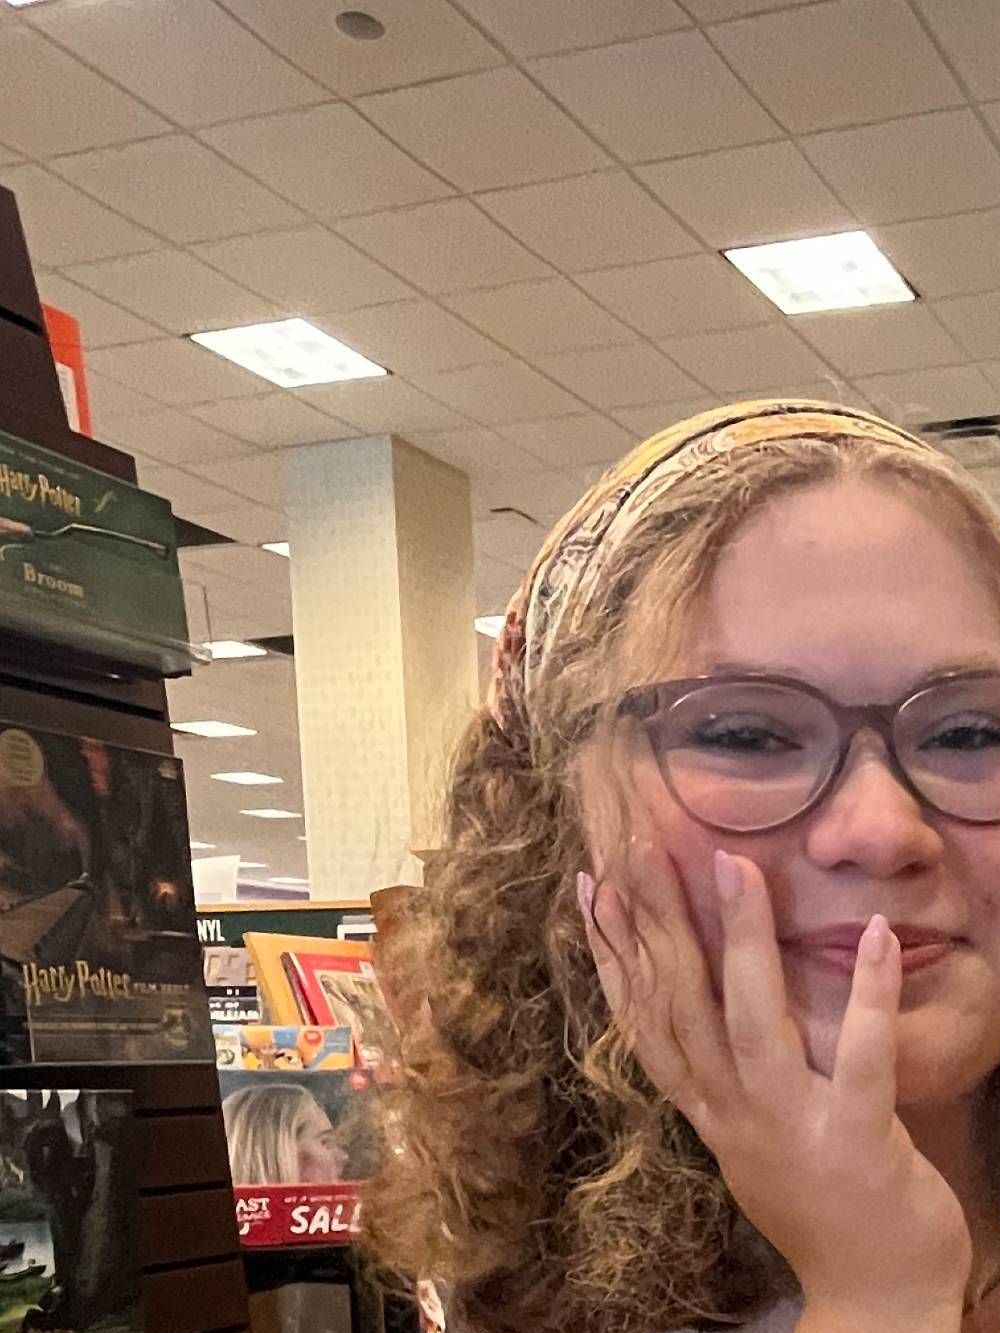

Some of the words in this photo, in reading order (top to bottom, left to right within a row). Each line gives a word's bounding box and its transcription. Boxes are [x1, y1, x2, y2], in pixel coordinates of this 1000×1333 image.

[23, 562, 84, 599] Broom
[22, 961, 76, 1006] Harry
[75, 960, 131, 1000] Potter
